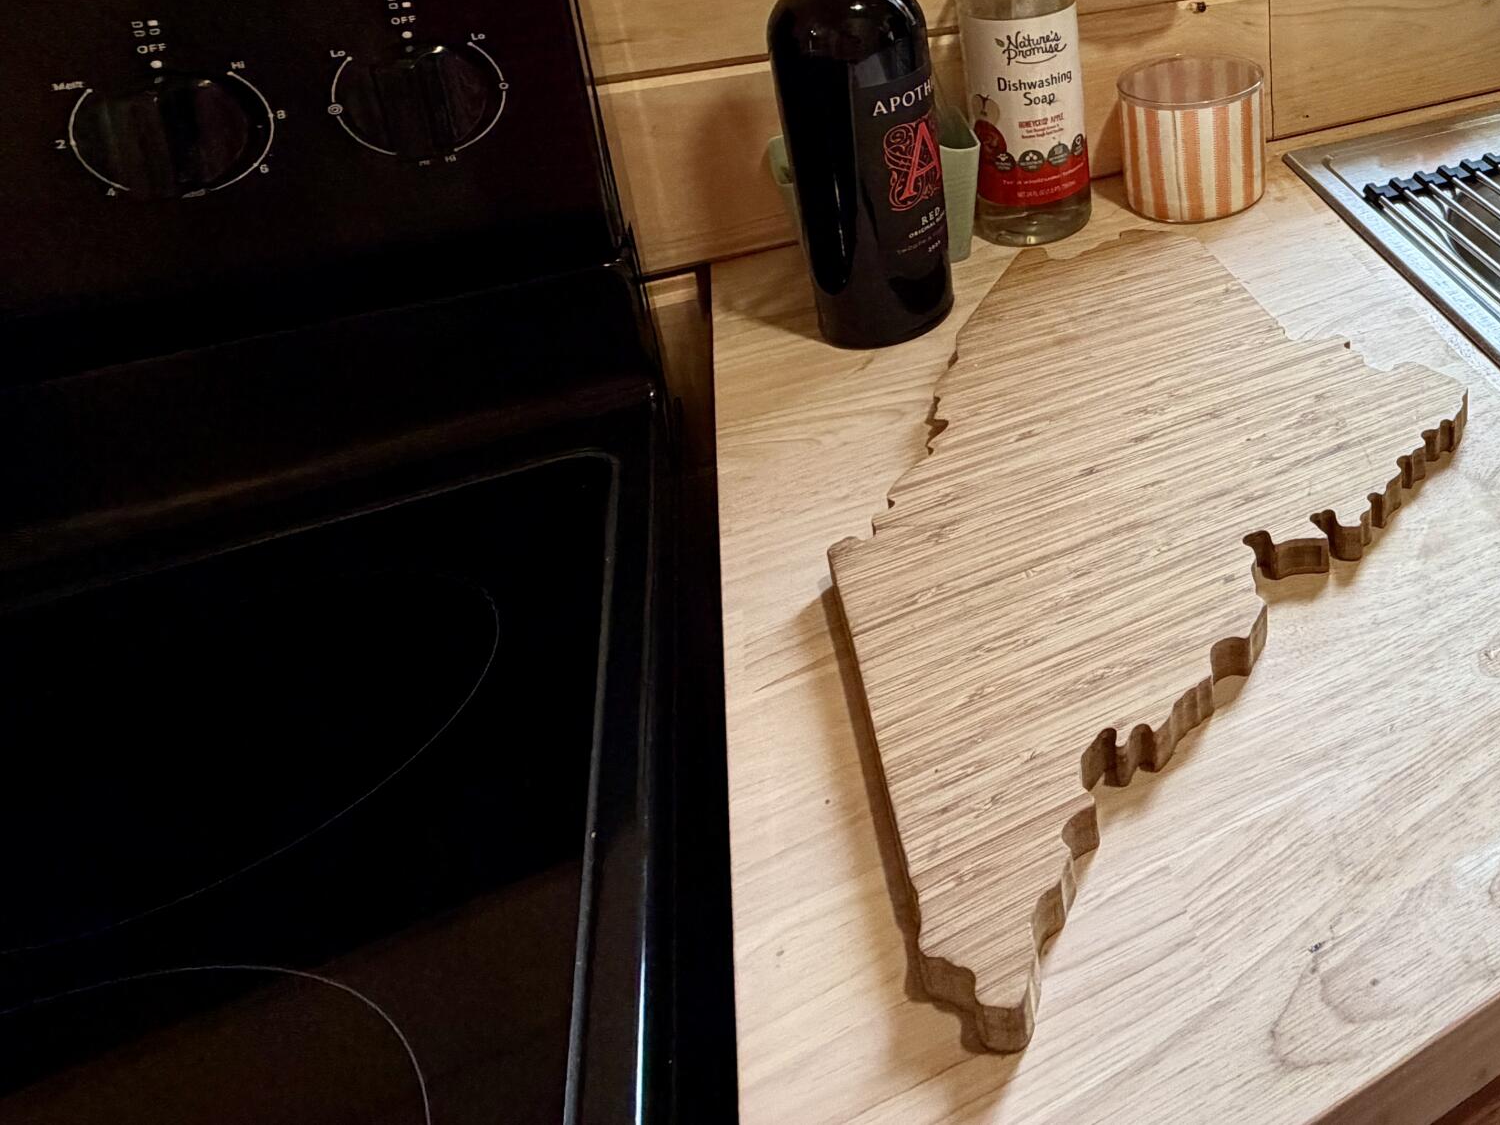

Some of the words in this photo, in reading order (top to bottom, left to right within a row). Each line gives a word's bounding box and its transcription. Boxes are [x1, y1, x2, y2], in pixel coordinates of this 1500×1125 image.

[391, 14, 416, 25] OFF
[471, 32, 486, 41] Lo
[1005, 30, 1062, 50] Nature's
[136, 43, 167, 54] OFF
[329, 49, 346, 58] Lo
[1002, 43, 1067, 66] Promise
[231, 60, 245, 70] Hi
[997, 70, 1072, 92] Dishwashing
[873, 78, 934, 117] APOTH
[1023, 91, 1057, 106] Soap
[276, 109, 286, 120] 8
[54, 139, 66, 149] 2
[259, 163, 270, 174] 6
[921, 206, 941, 226] RED
